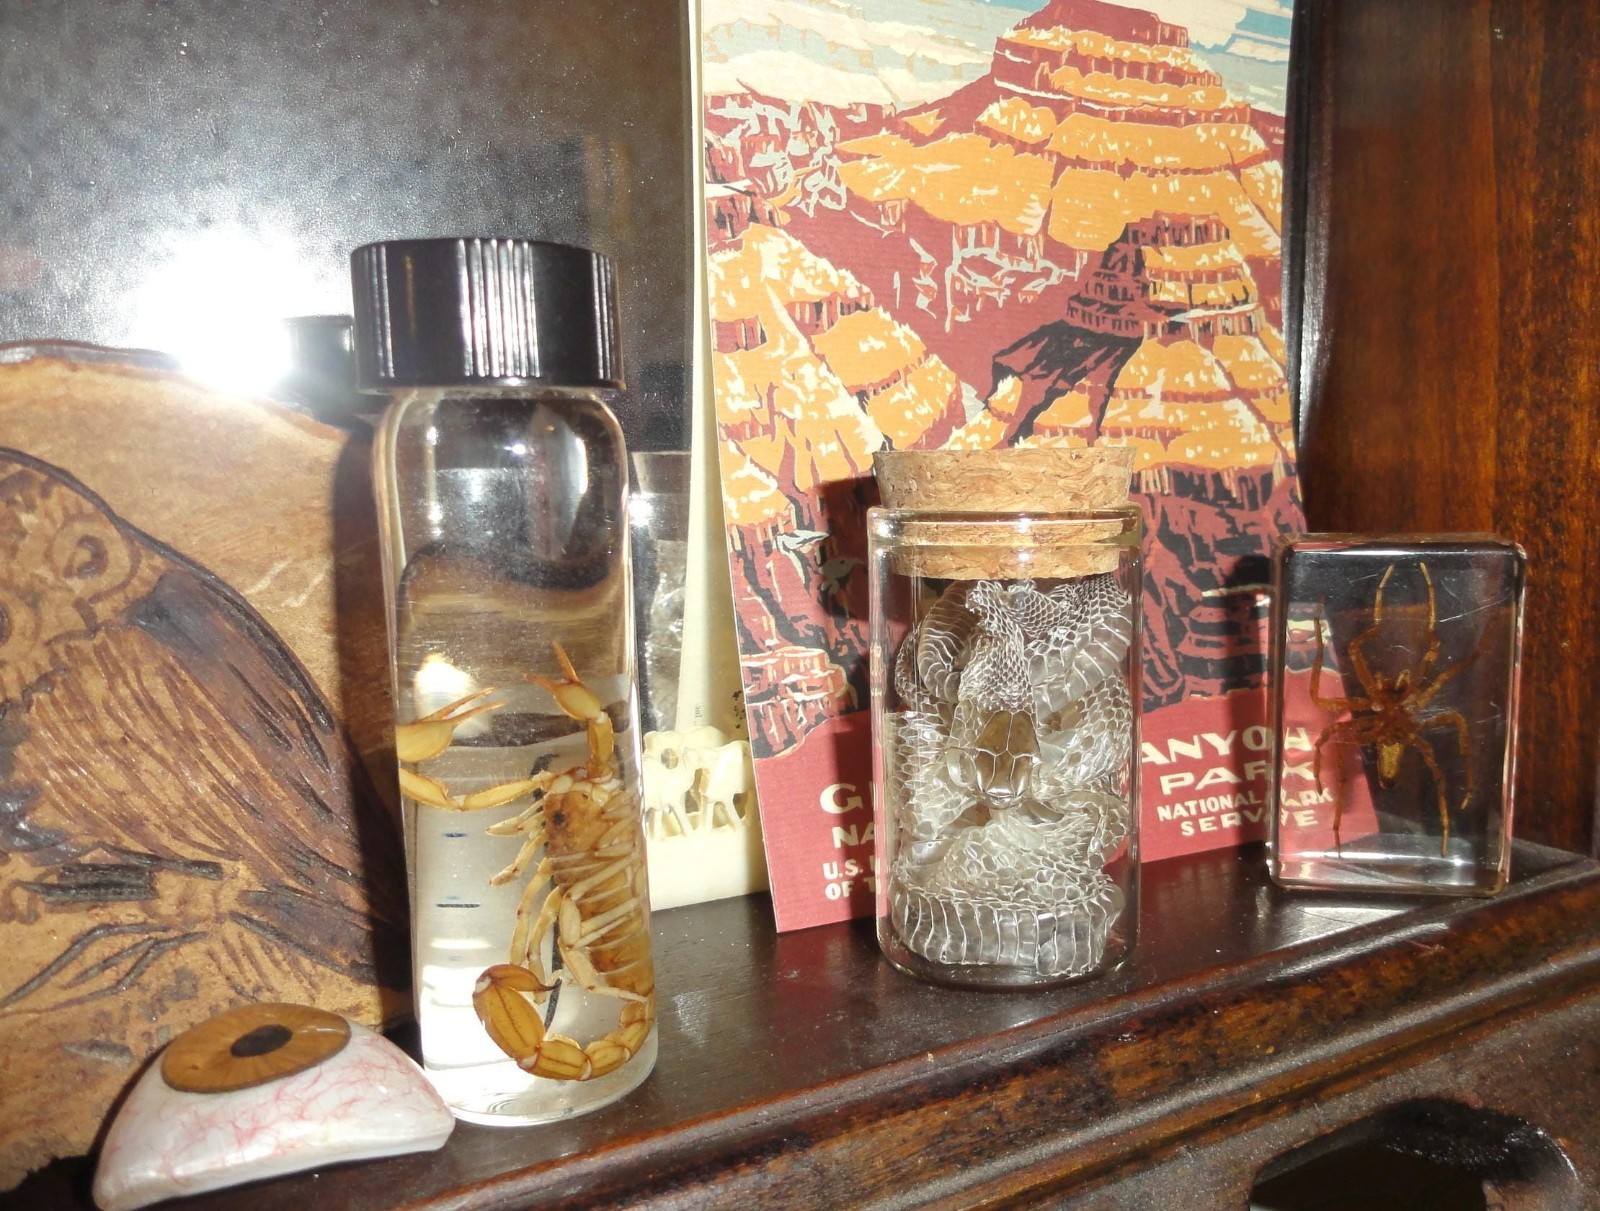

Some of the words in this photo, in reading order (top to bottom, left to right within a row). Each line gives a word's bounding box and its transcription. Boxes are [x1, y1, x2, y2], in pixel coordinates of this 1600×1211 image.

[1157, 791, 1262, 821] NATIONAL
[1181, 807, 1318, 836] SERVE
[825, 881, 854, 900] OF
